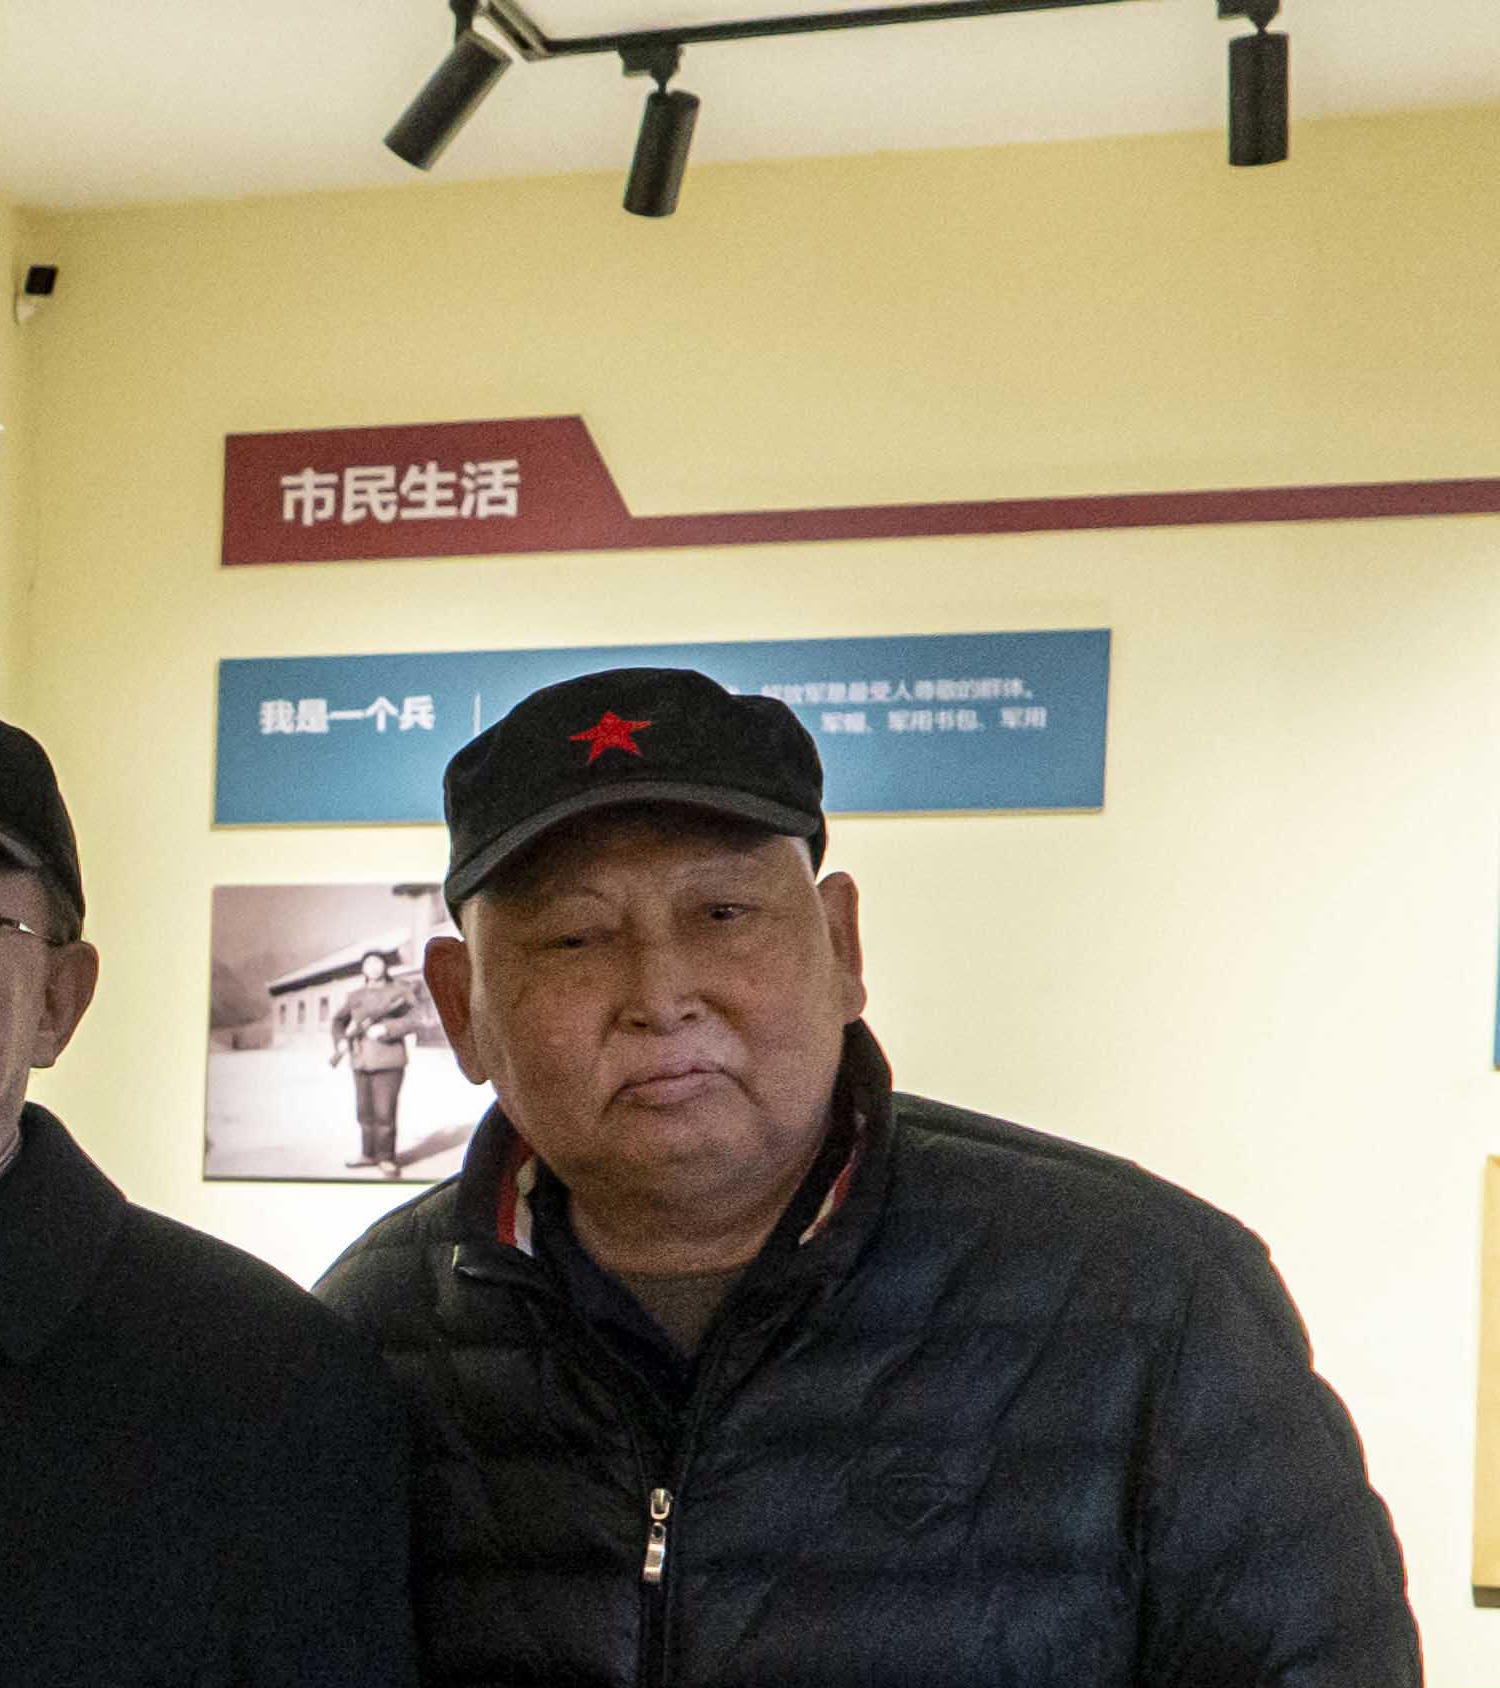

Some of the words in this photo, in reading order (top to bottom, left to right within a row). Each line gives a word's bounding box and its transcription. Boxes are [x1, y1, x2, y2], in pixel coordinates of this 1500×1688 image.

[280, 459, 521, 526] 市民生活
[259, 695, 436, 734] 我是一个兵
